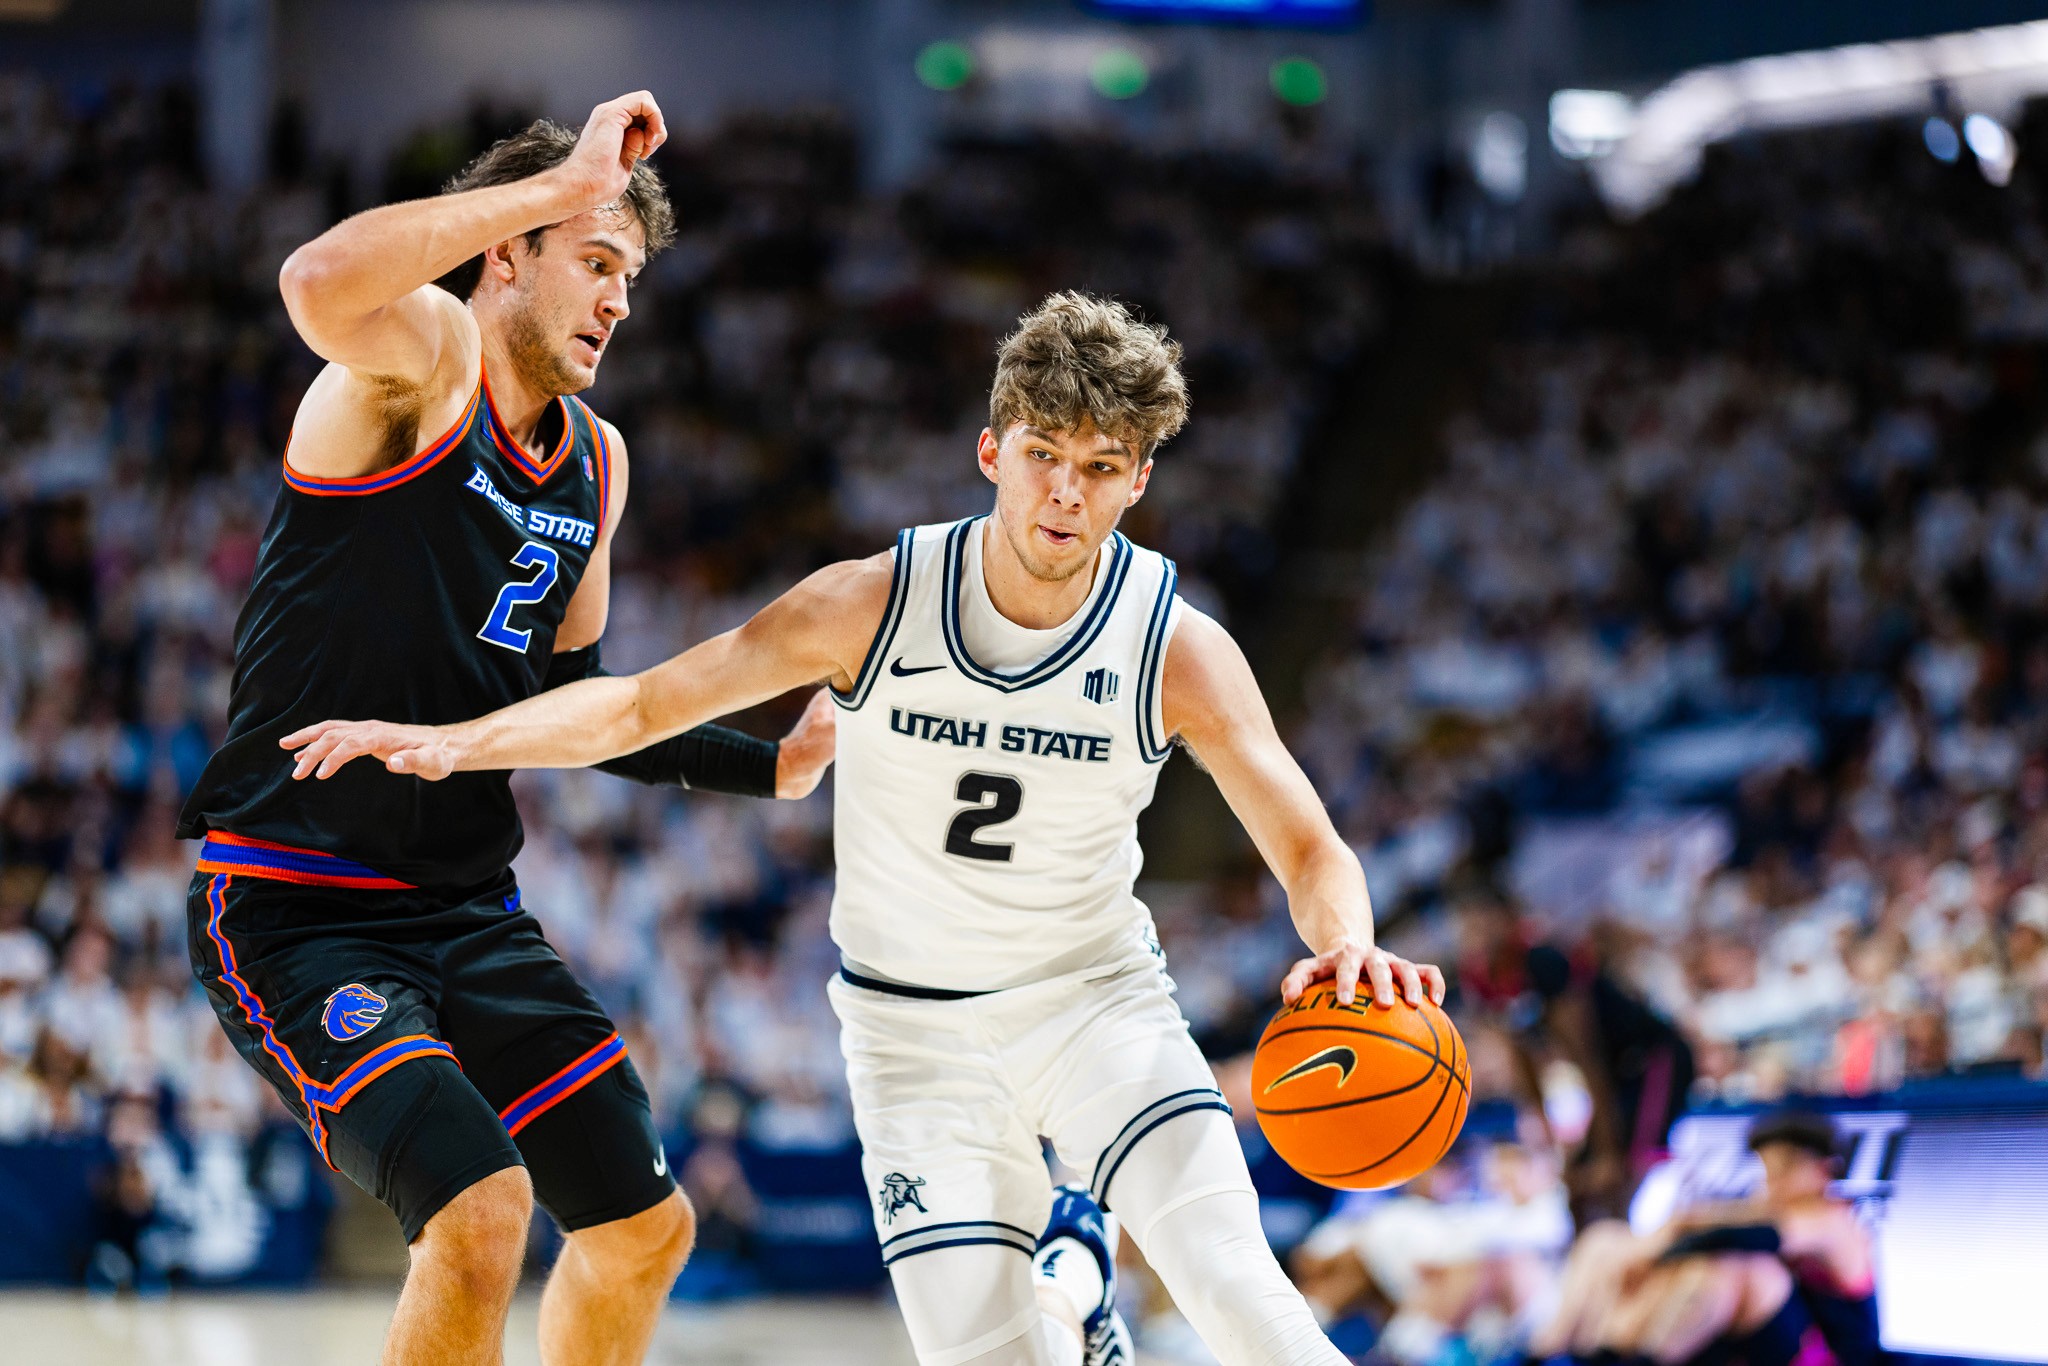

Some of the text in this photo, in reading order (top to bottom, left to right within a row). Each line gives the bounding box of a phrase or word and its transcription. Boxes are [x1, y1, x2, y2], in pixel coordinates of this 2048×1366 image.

[526, 508, 596, 548] STATE
[476, 541, 559, 654] 2
[889, 705, 1113, 763] UTAH STATE
[943, 769, 1025, 863] 2
